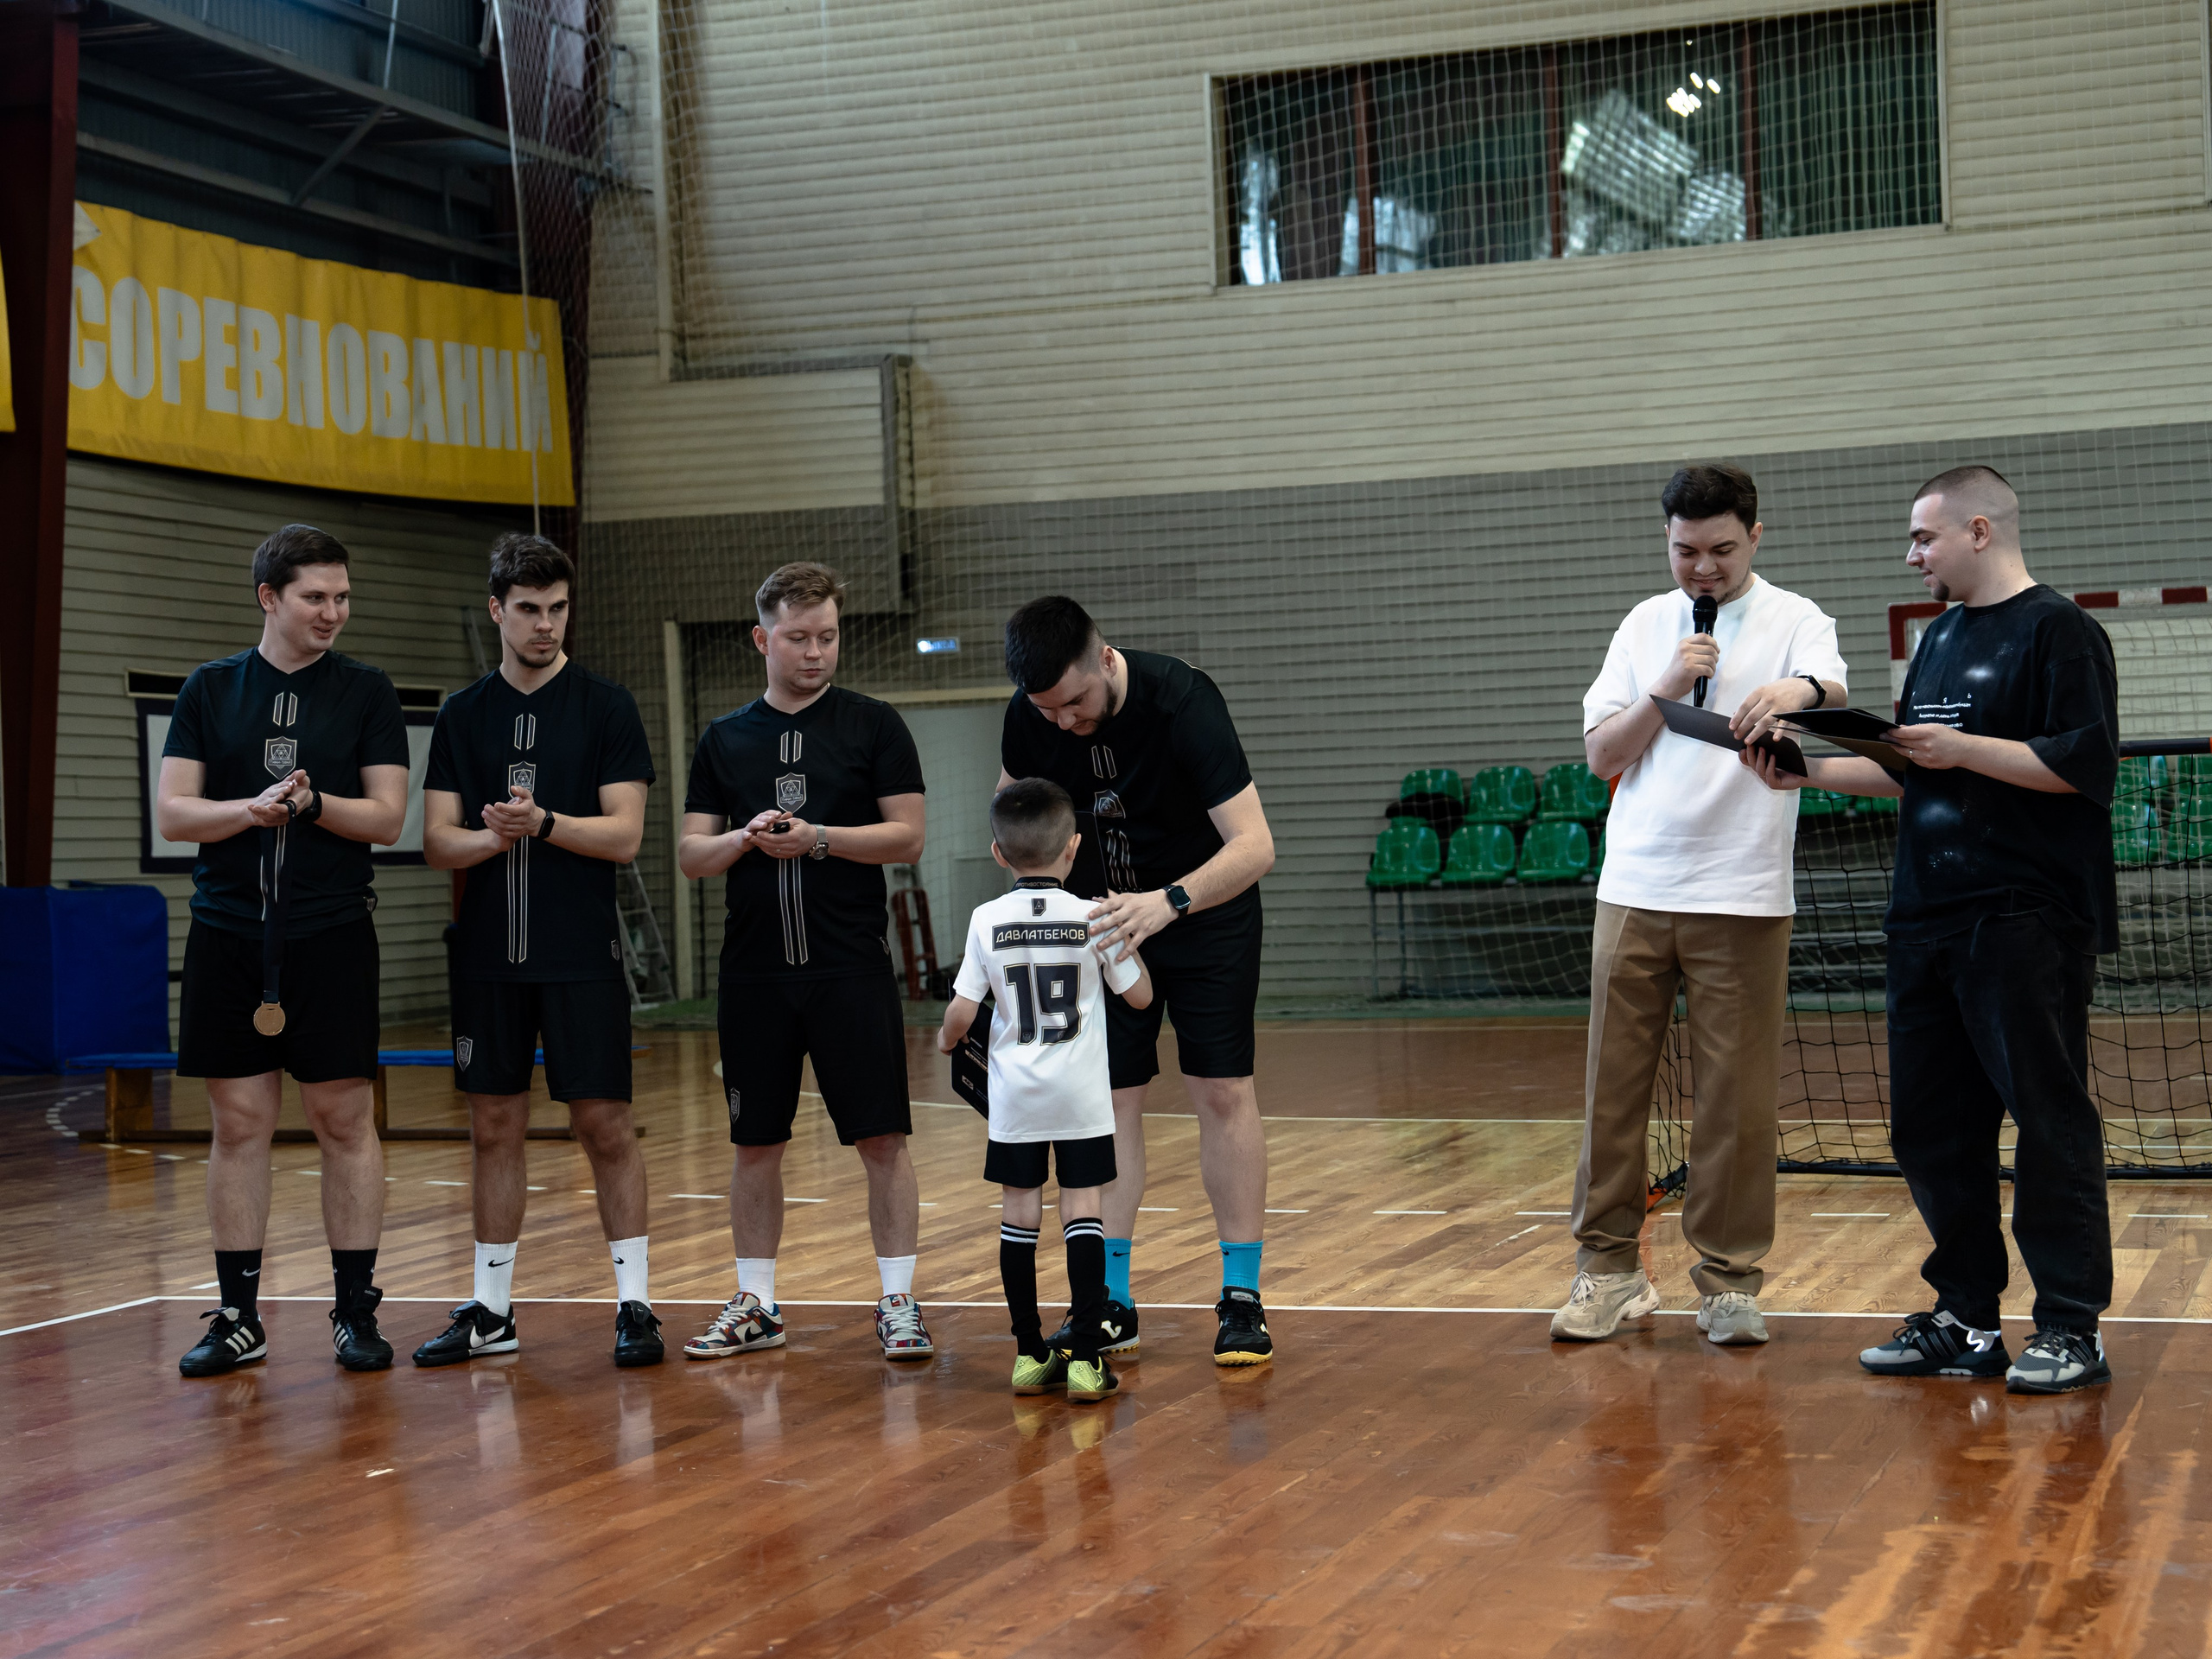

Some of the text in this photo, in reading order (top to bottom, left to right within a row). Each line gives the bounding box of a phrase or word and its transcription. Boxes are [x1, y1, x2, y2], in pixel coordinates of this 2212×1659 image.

[68, 265, 553, 453] СОРЕВНОВАНИЙ
[995, 928, 1086, 944] ДАВЛАТБЕКОВ
[1003, 963, 1082, 1046] 19
